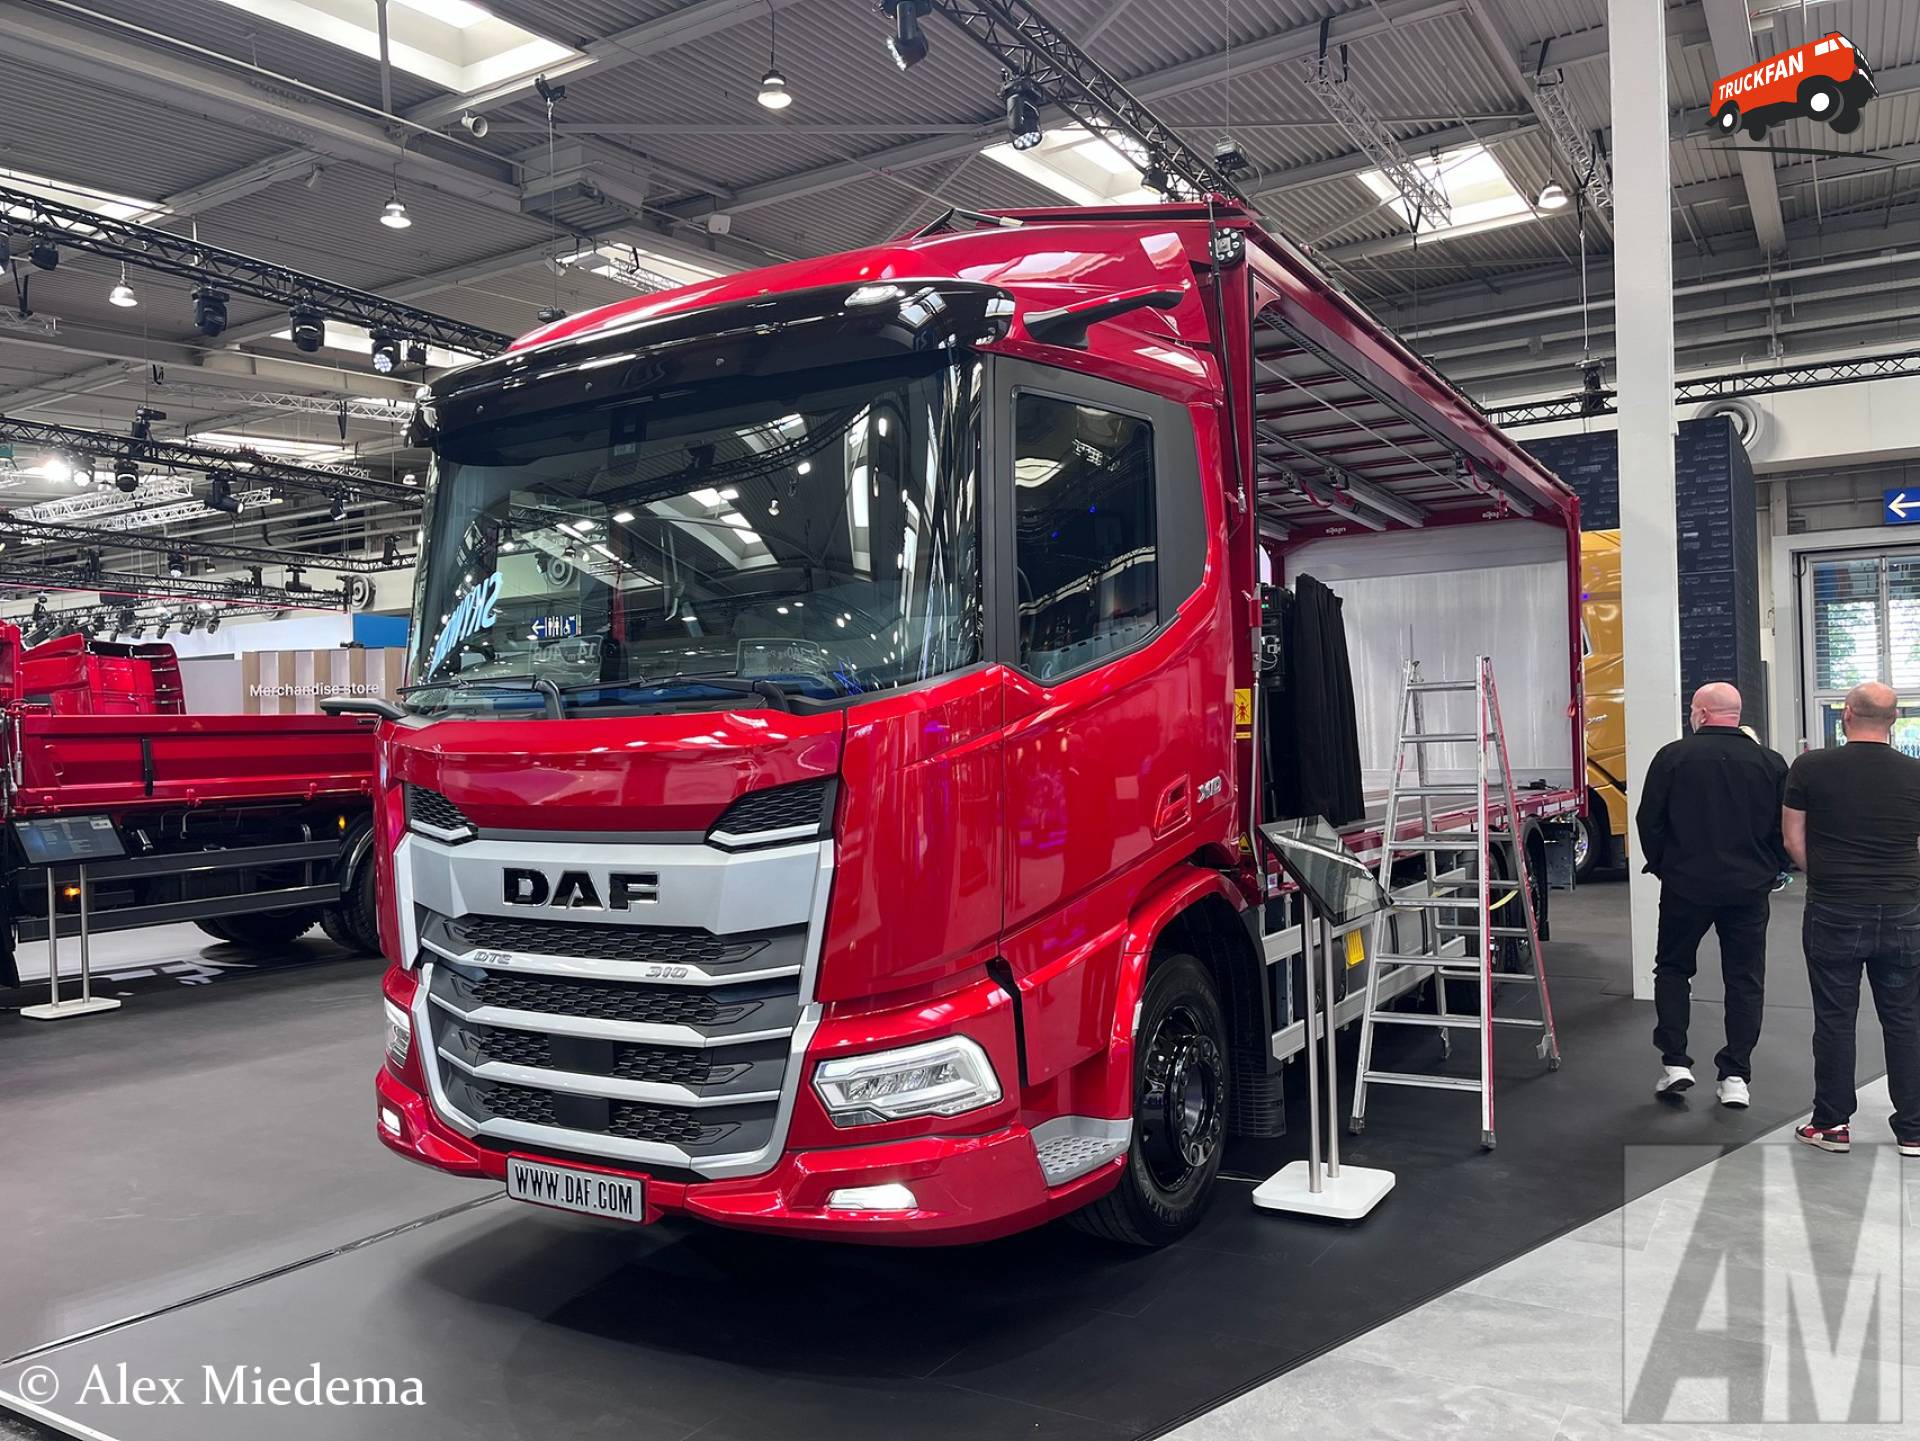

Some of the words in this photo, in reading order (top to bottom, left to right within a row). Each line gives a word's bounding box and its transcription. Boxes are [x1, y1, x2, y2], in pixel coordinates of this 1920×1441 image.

[250, 682, 340, 697] Merchandise
[344, 681, 379, 695] store
[502, 867, 660, 912] DAF
[645, 966, 689, 979] 310
[514, 1163, 633, 1215] WWW.DAF.COM
